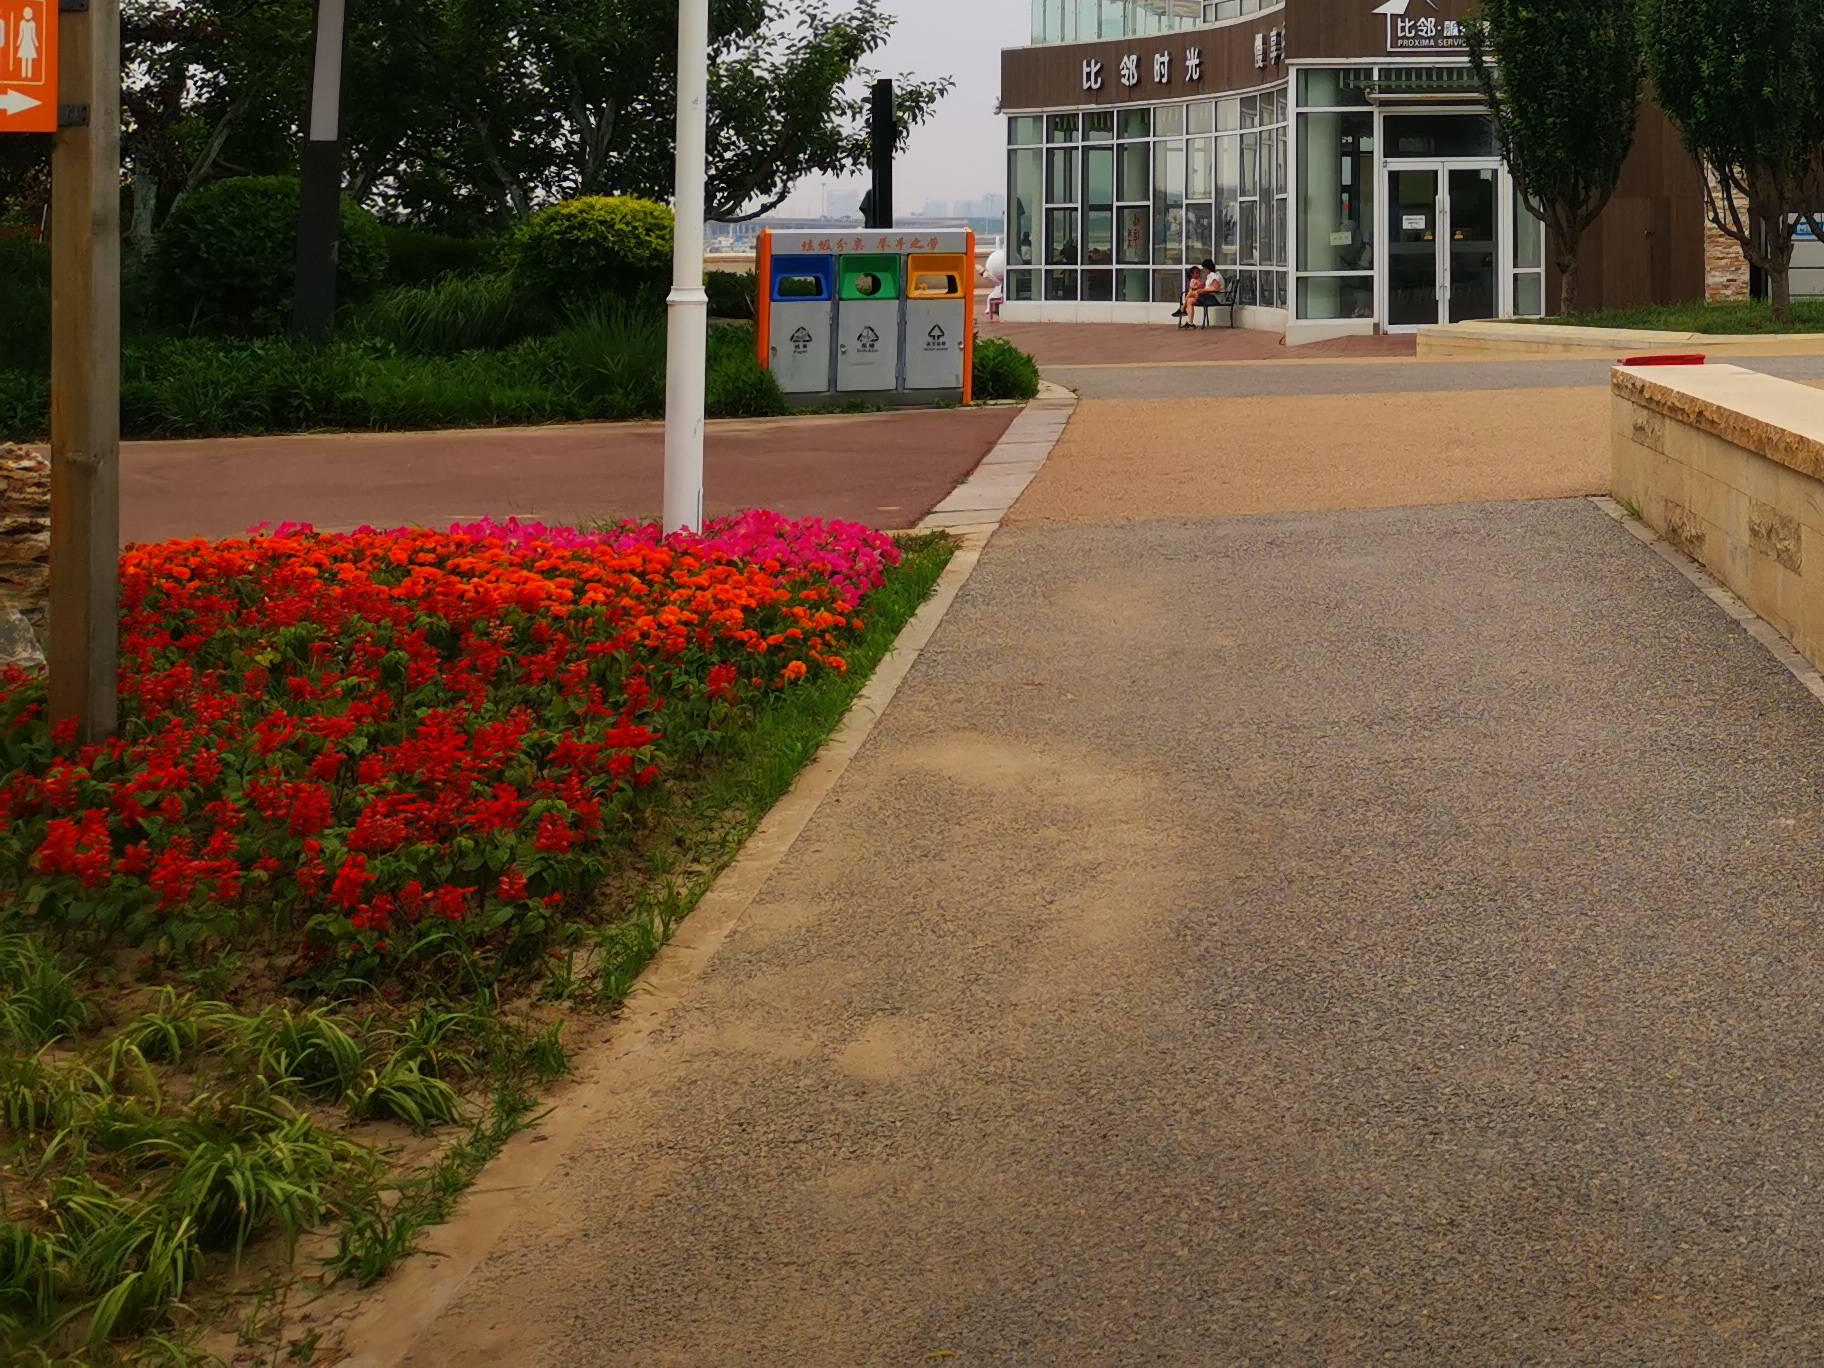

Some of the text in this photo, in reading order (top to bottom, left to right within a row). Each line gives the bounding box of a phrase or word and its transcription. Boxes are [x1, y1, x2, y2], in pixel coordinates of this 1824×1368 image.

[1398, 38, 1467, 47] PROXIMA SERVIC
[1082, 46, 1200, 91] 比邻时光
